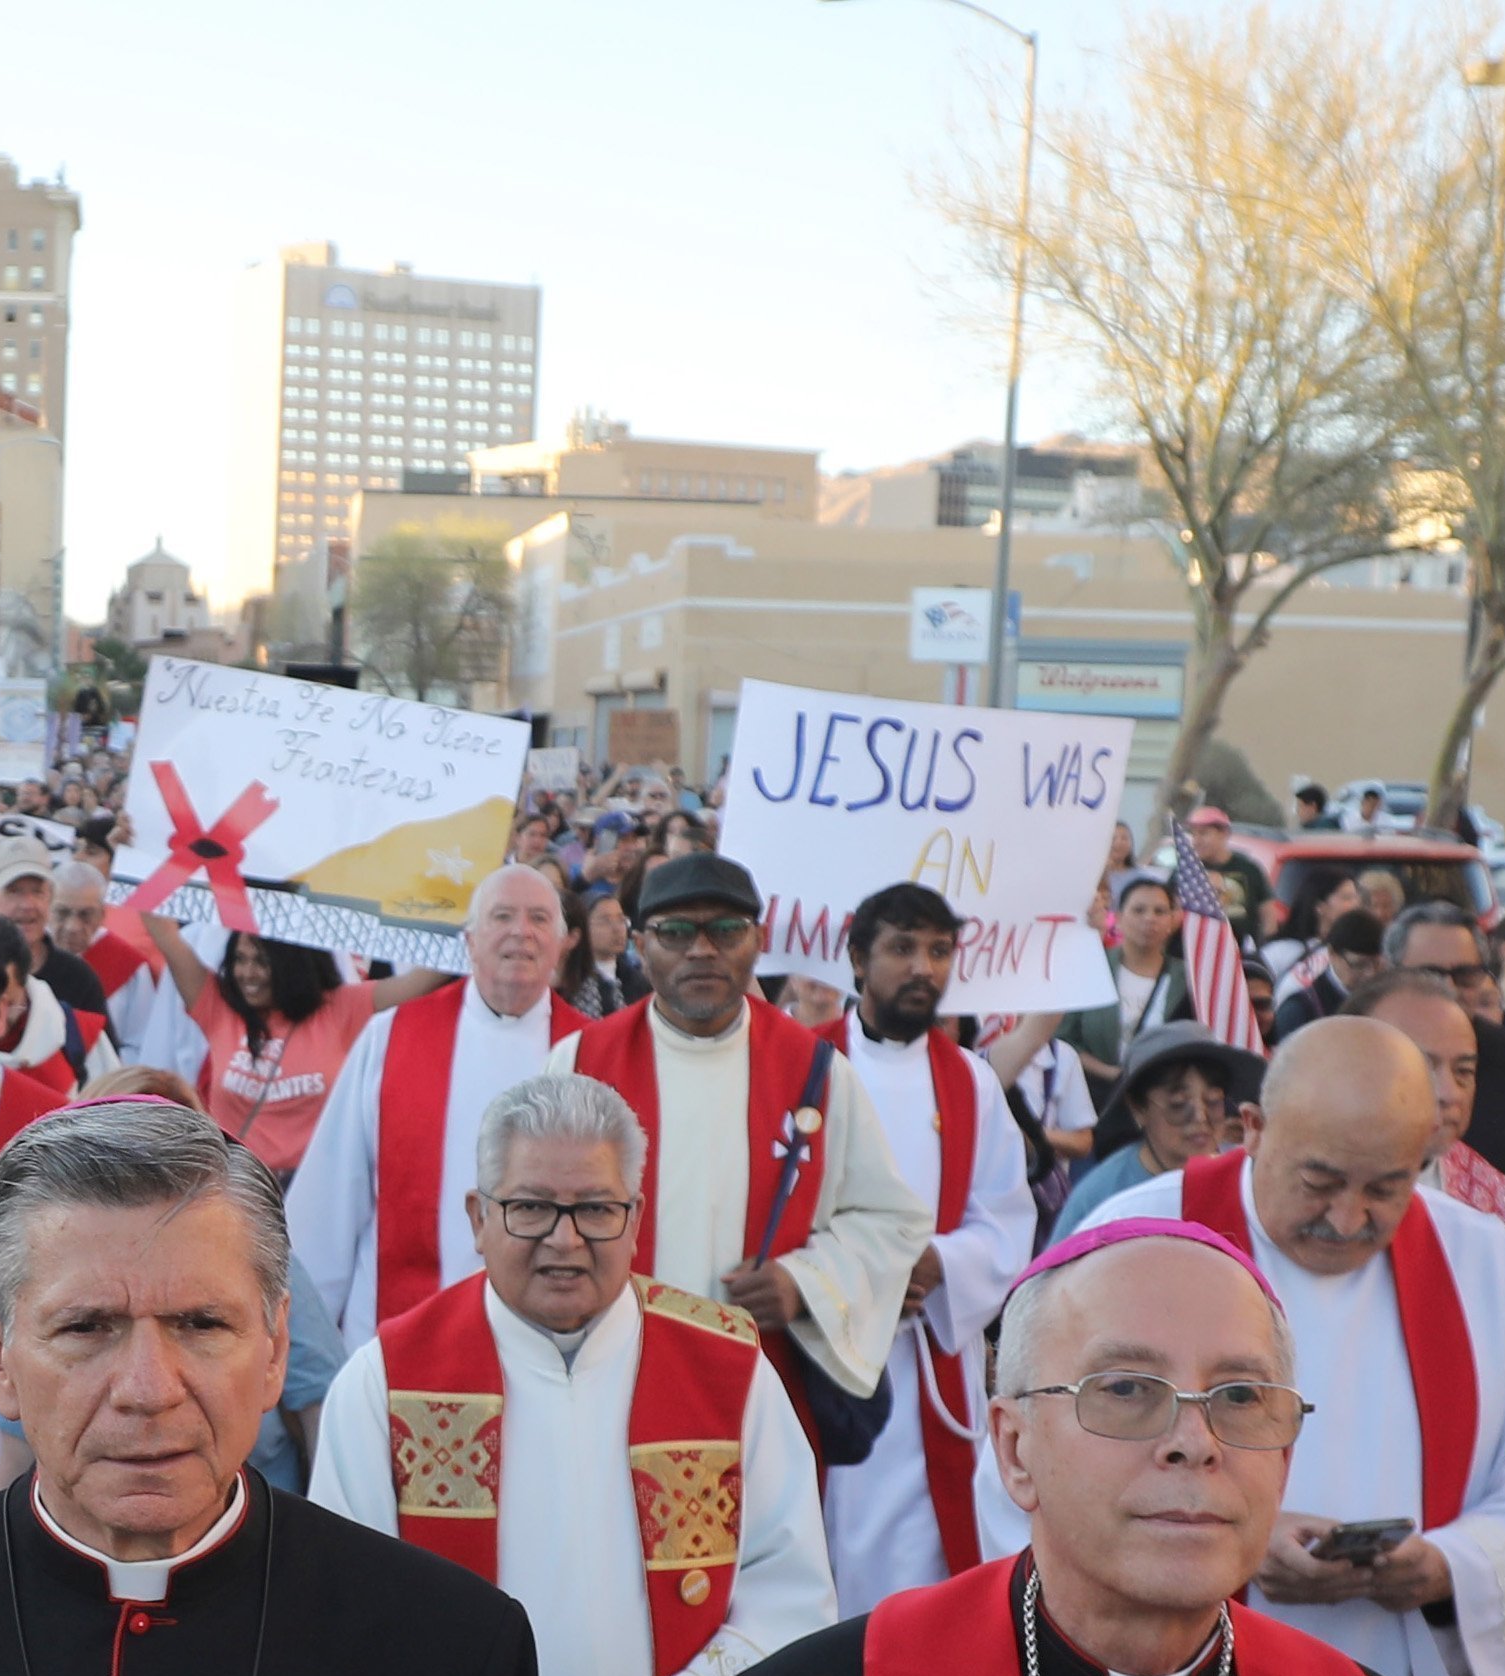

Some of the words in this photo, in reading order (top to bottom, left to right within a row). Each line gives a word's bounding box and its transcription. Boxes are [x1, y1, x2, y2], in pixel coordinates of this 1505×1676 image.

[1038, 664, 1160, 695] Walgreens
[292, 681, 335, 725] Fe
[349, 698, 408, 741] No
[424, 705, 502, 757] Tiene
[752, 710, 983, 815] JESUS
[1020, 743, 1112, 810] WAS
[908, 826, 995, 898] AN
[760, 893, 1077, 983] IMMRANT
